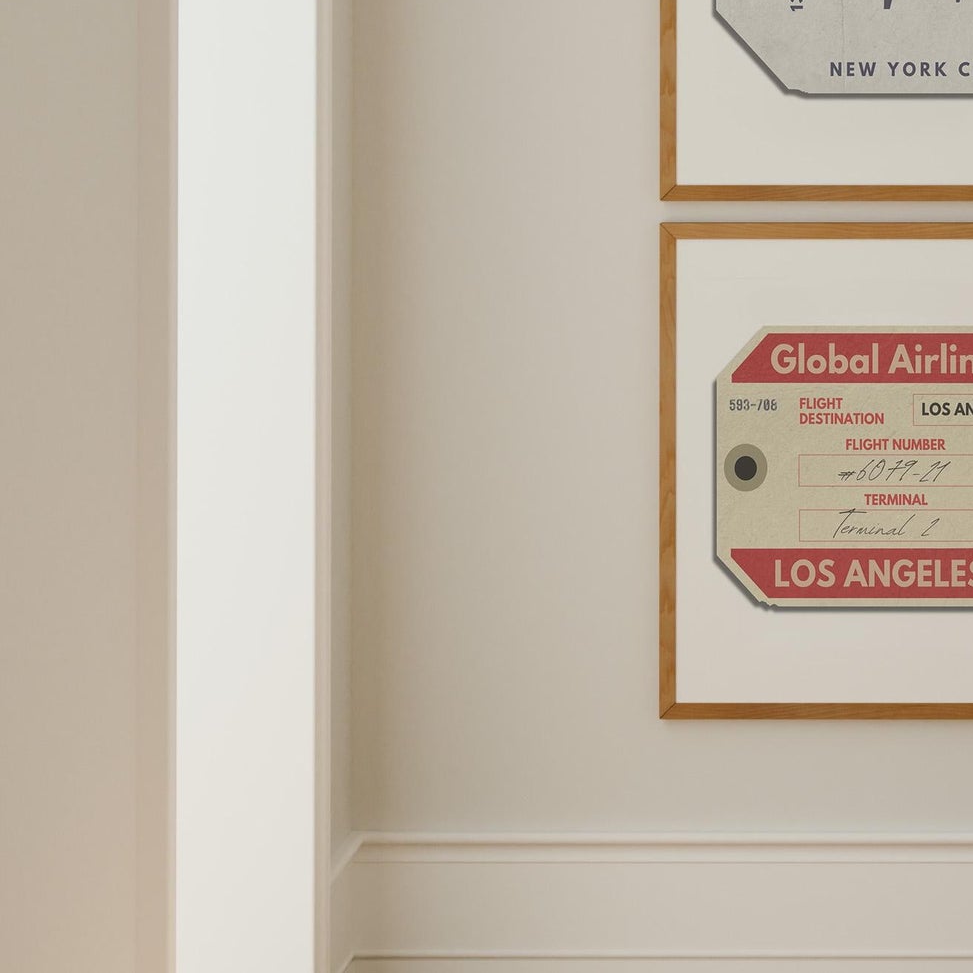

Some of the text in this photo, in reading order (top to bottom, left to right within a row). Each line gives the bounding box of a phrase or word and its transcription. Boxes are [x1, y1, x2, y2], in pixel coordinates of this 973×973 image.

[830, 61, 877, 77] NEW
[888, 61, 948, 77] YORK
[770, 343, 880, 375] Global
[799, 398, 842, 409] FLIGHT
[921, 402, 952, 416] LOS
[799, 413, 884, 424] DESTINATION
[846, 439, 946, 451] FLIGHT NUMBER
[864, 494, 928, 506] TERMINAL
[832, 508, 916, 538] Terminal
[774, 558, 835, 589] LOS
